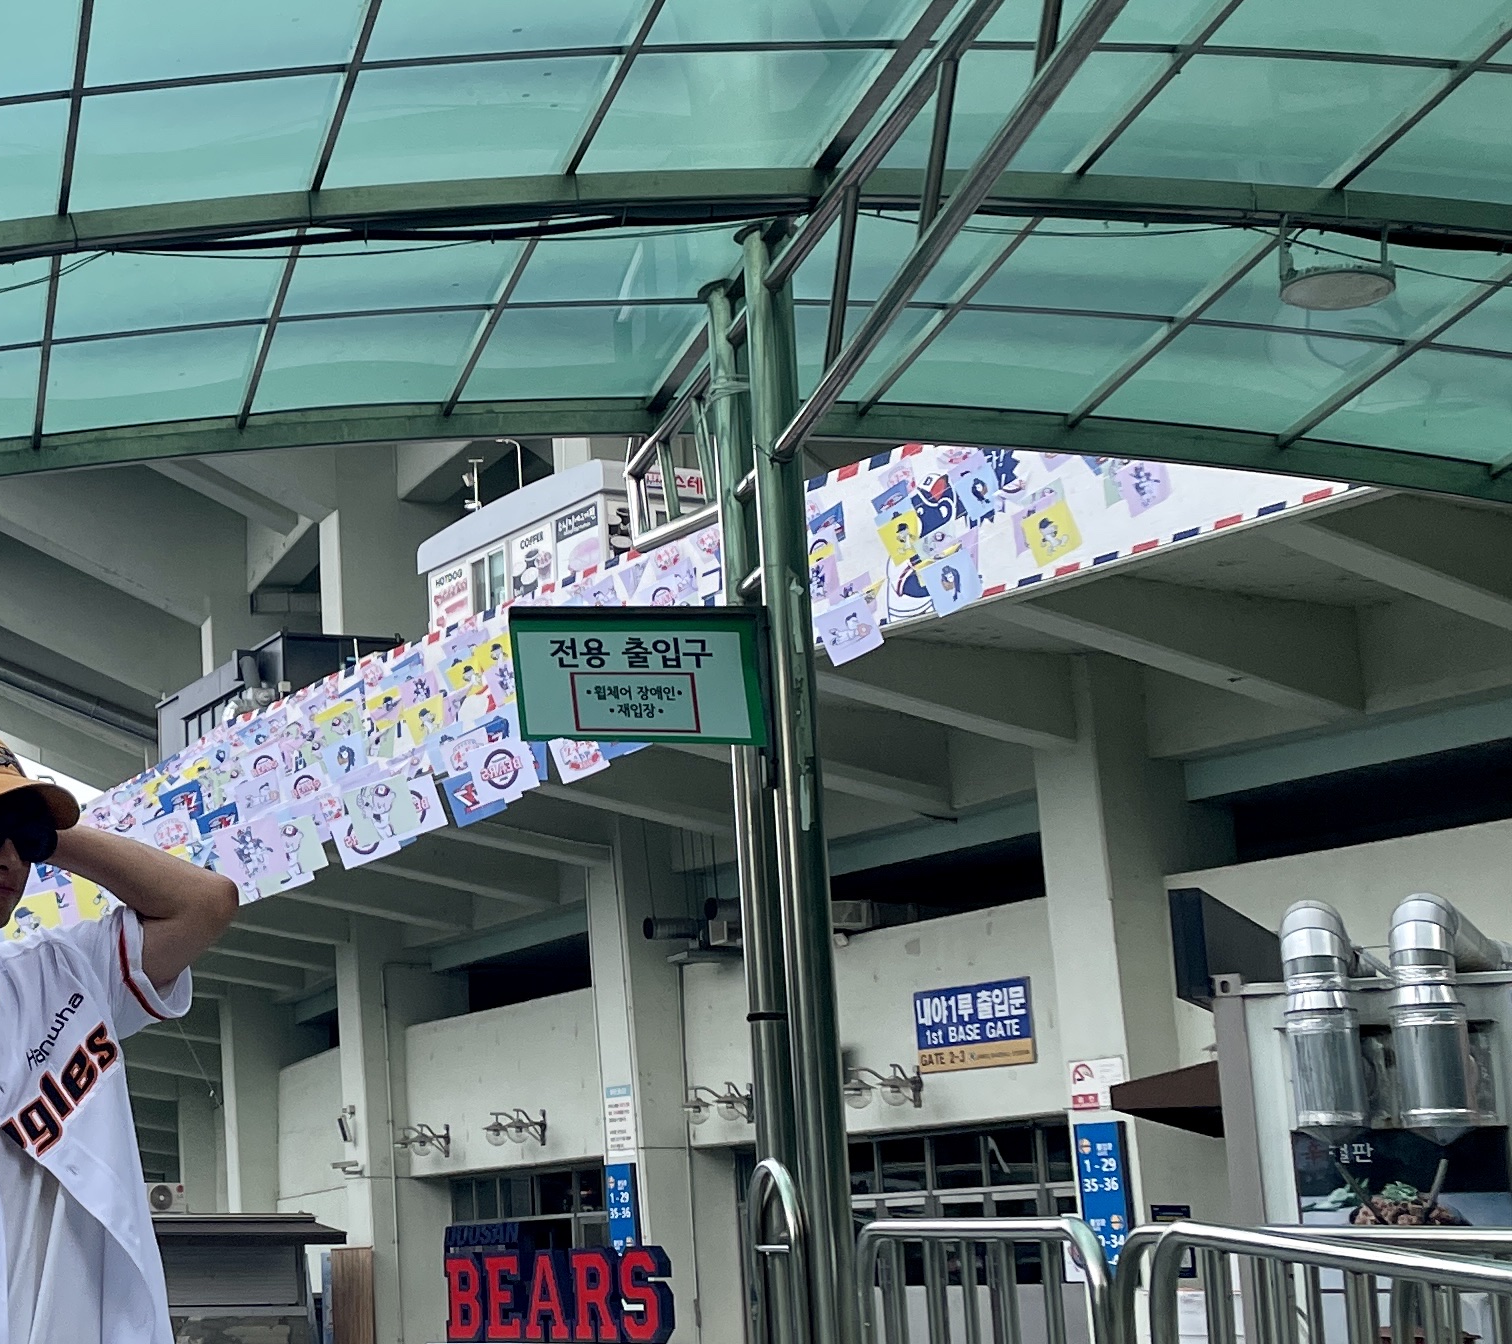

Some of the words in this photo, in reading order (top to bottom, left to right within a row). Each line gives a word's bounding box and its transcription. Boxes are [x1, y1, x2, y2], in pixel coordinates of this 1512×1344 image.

[549, 637, 610, 669] 전용
[621, 637, 713, 669] 출입구
[594, 685, 631, 701] 휠체어
[637, 685, 676, 701] 장애인
[617, 703, 655, 718] 재입장
[915, 993, 975, 1026] 내야1루
[976, 985, 1027, 1020] 출입문
[25, 992, 85, 1071] Hanwha
[925, 1029, 944, 1045] 1st
[947, 1023, 982, 1043] BASE
[985, 1018, 1021, 1039] GATE
[920, 1052, 946, 1067] GATE
[1082, 1177, 1120, 1193] 35-36
[444, 1248, 665, 1343] BEARS
